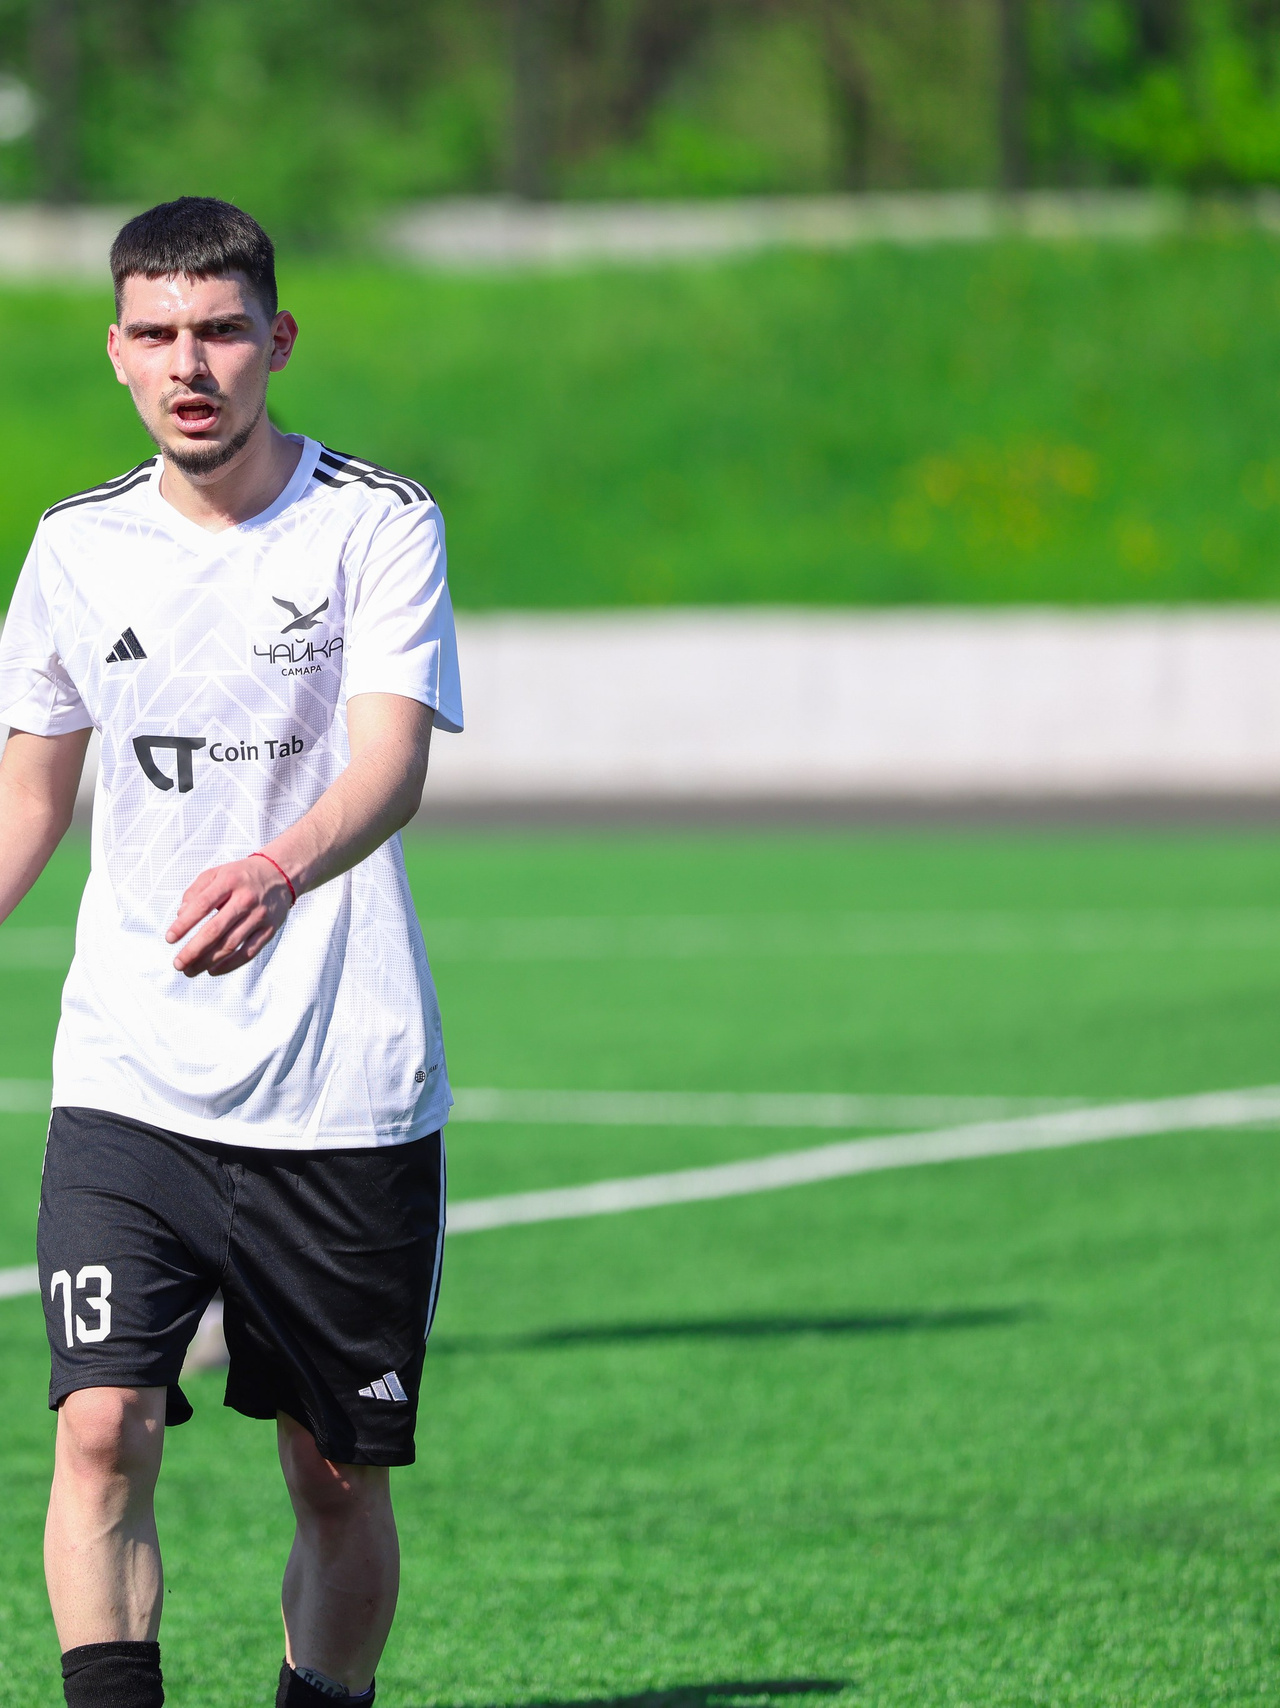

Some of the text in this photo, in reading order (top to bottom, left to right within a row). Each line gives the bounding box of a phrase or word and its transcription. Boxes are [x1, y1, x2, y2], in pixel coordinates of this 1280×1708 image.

[253, 637, 344, 664] ЧАЙКА
[281, 664, 322, 677] САМАРА
[209, 740, 259, 762] Coin
[264, 735, 304, 760] Tab
